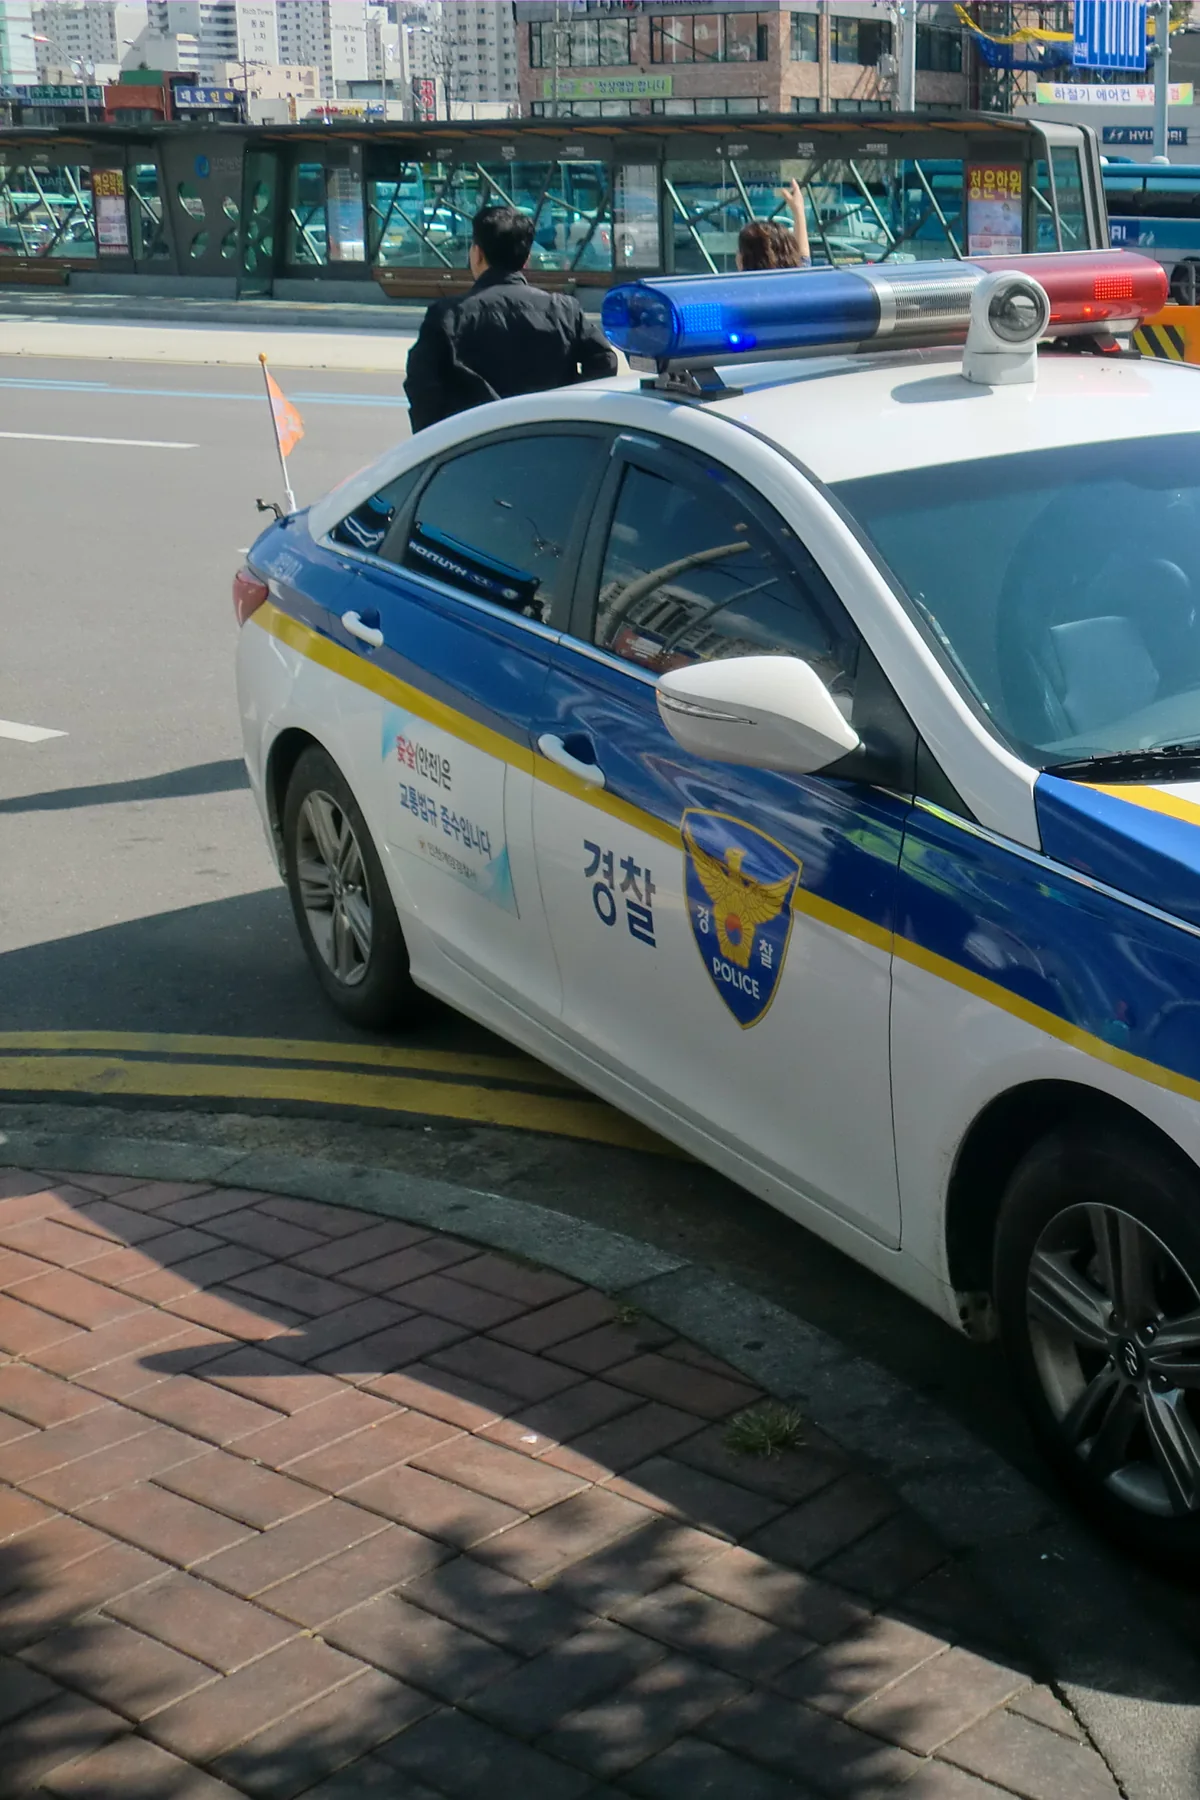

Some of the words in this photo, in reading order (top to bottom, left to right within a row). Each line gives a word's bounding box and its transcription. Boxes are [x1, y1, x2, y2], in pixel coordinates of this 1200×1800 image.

[1055, 88, 1090, 102] 하절기
[1096, 88, 1131, 102] 에어컨
[399, 782, 438, 827] 교통법규
[440, 804, 493, 860] 준수입니다
[583, 839, 657, 948] 경찰
[696, 904, 710, 934] 경
[759, 938, 774, 969] 찰
[712, 956, 761, 1000] POLICE
